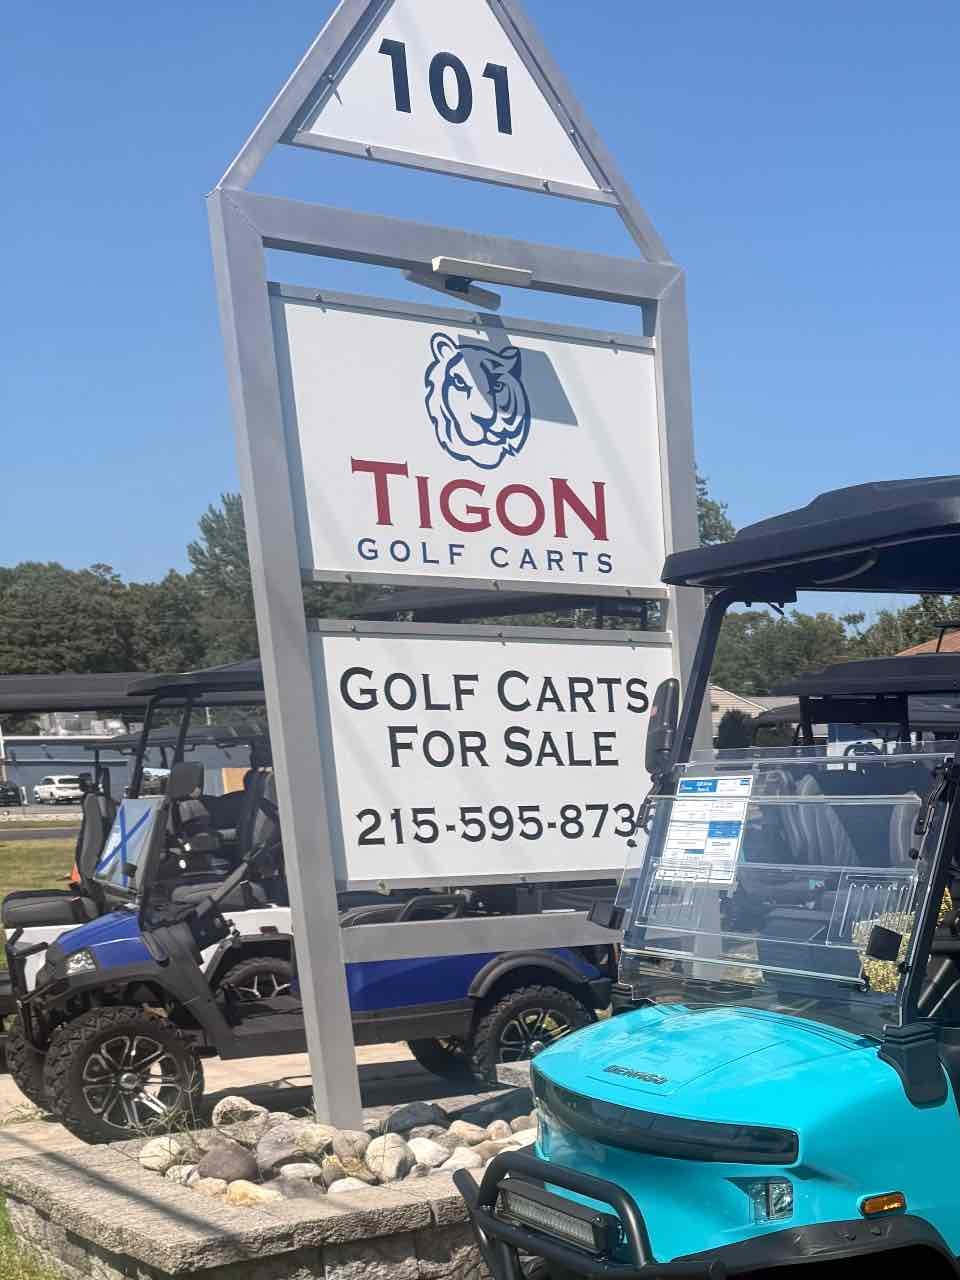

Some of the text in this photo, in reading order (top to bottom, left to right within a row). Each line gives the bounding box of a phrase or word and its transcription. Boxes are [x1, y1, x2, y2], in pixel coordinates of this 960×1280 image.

[378, 38, 513, 136] 101
[350, 455, 609, 542] TIGON
[357, 537, 613, 574] GOLF CARTS
[339, 666, 650, 714] GOLF CARTS
[387, 725, 619, 768] FOR SALE
[355, 803, 650, 847] 215-595-873
